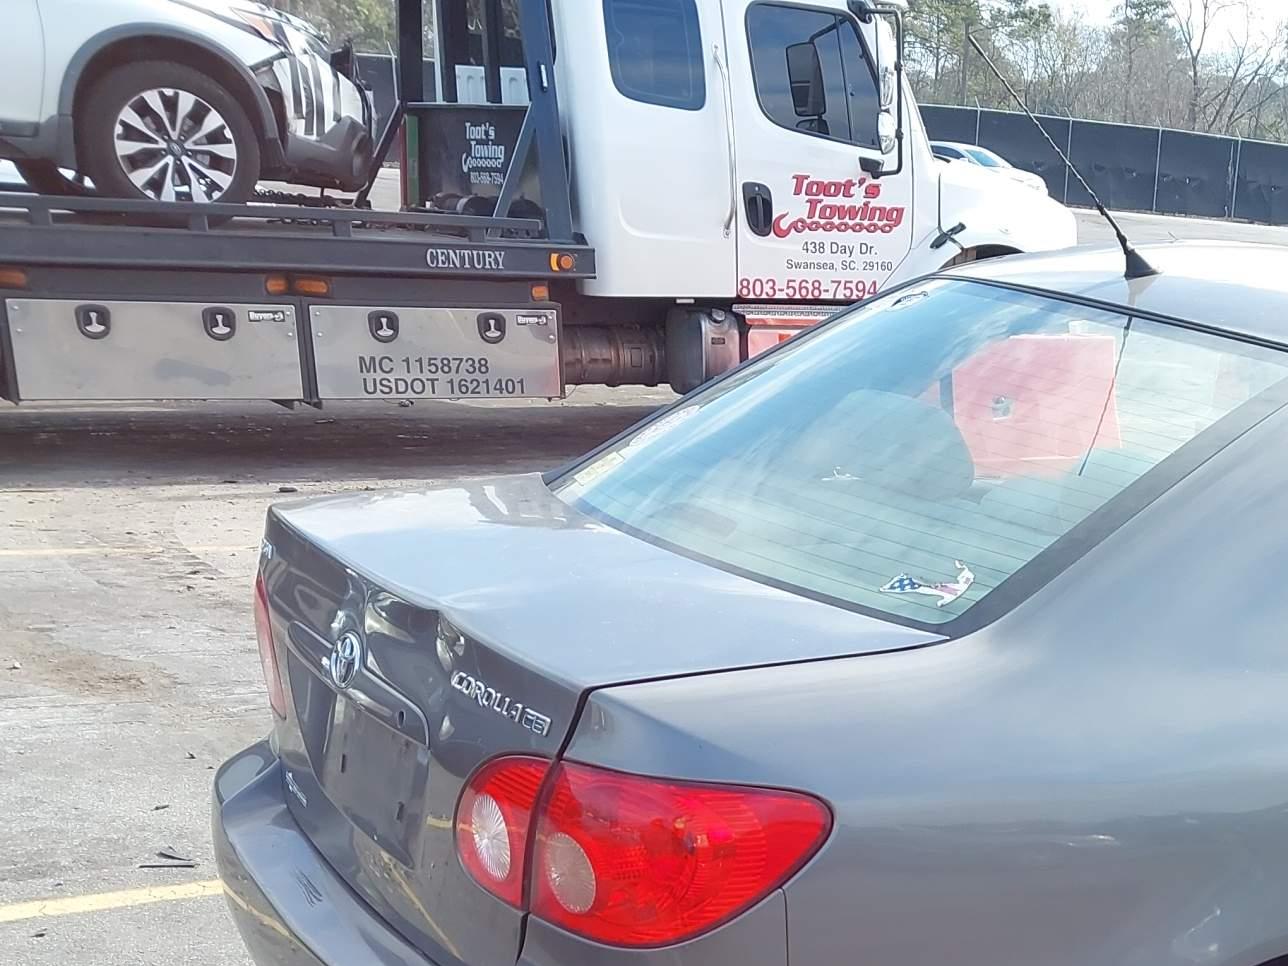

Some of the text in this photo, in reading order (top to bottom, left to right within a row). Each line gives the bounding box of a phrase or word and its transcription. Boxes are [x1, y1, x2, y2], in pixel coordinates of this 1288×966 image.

[465, 122, 496, 140] Toot's
[470, 140, 505, 162] Towing
[792, 174, 882, 199] Toot's
[805, 199, 904, 227] Towing
[426, 248, 505, 269] CENTURY
[802, 241, 878, 257] 438 Day Dr.
[786, 259, 893, 272] Swansea, SC. 29160
[739, 278, 878, 299] 803-568-7594
[358, 356, 489, 375] MC 1158738
[363, 377, 526, 395] USDOT 1621401
[451, 670, 523, 723] COROLLA
